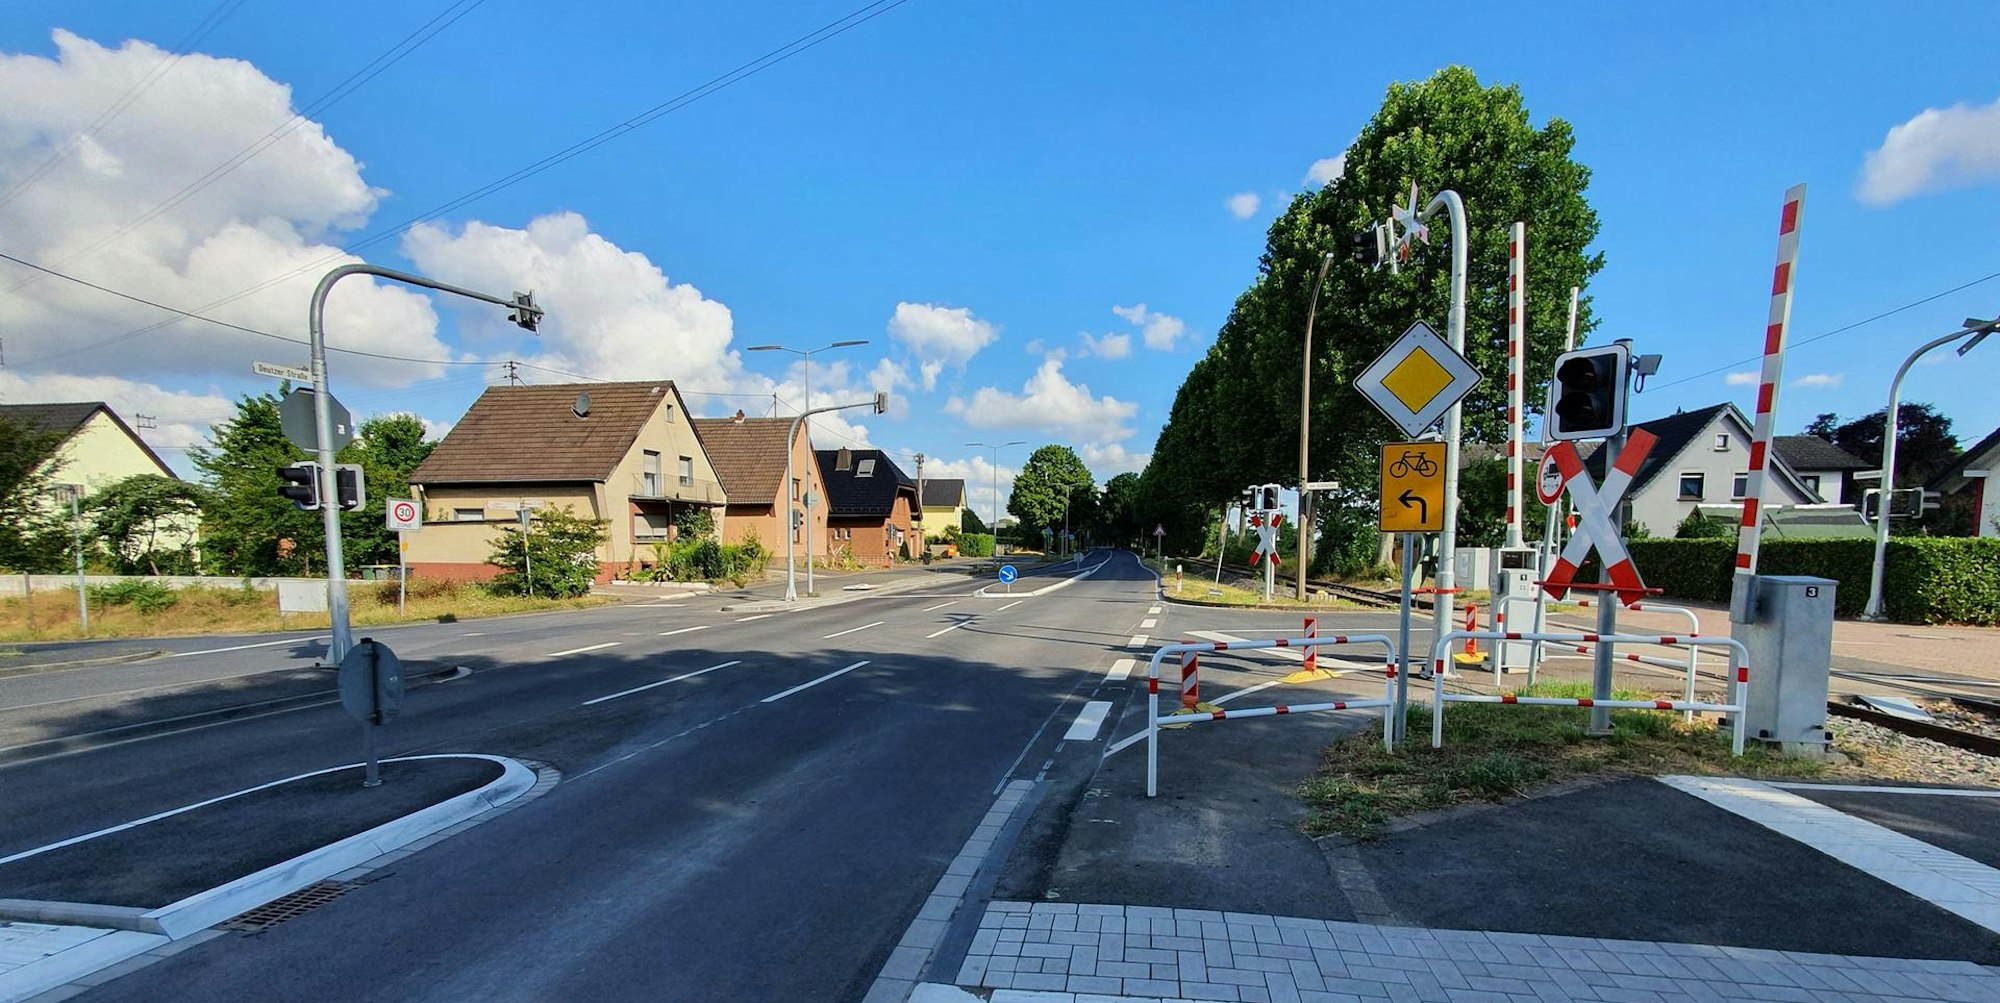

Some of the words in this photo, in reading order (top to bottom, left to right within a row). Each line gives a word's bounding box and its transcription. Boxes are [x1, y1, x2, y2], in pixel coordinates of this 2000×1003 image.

[258, 363, 284, 376] Deutzer
[399, 507, 410, 517] 30
[1808, 587, 1816, 596] 3
